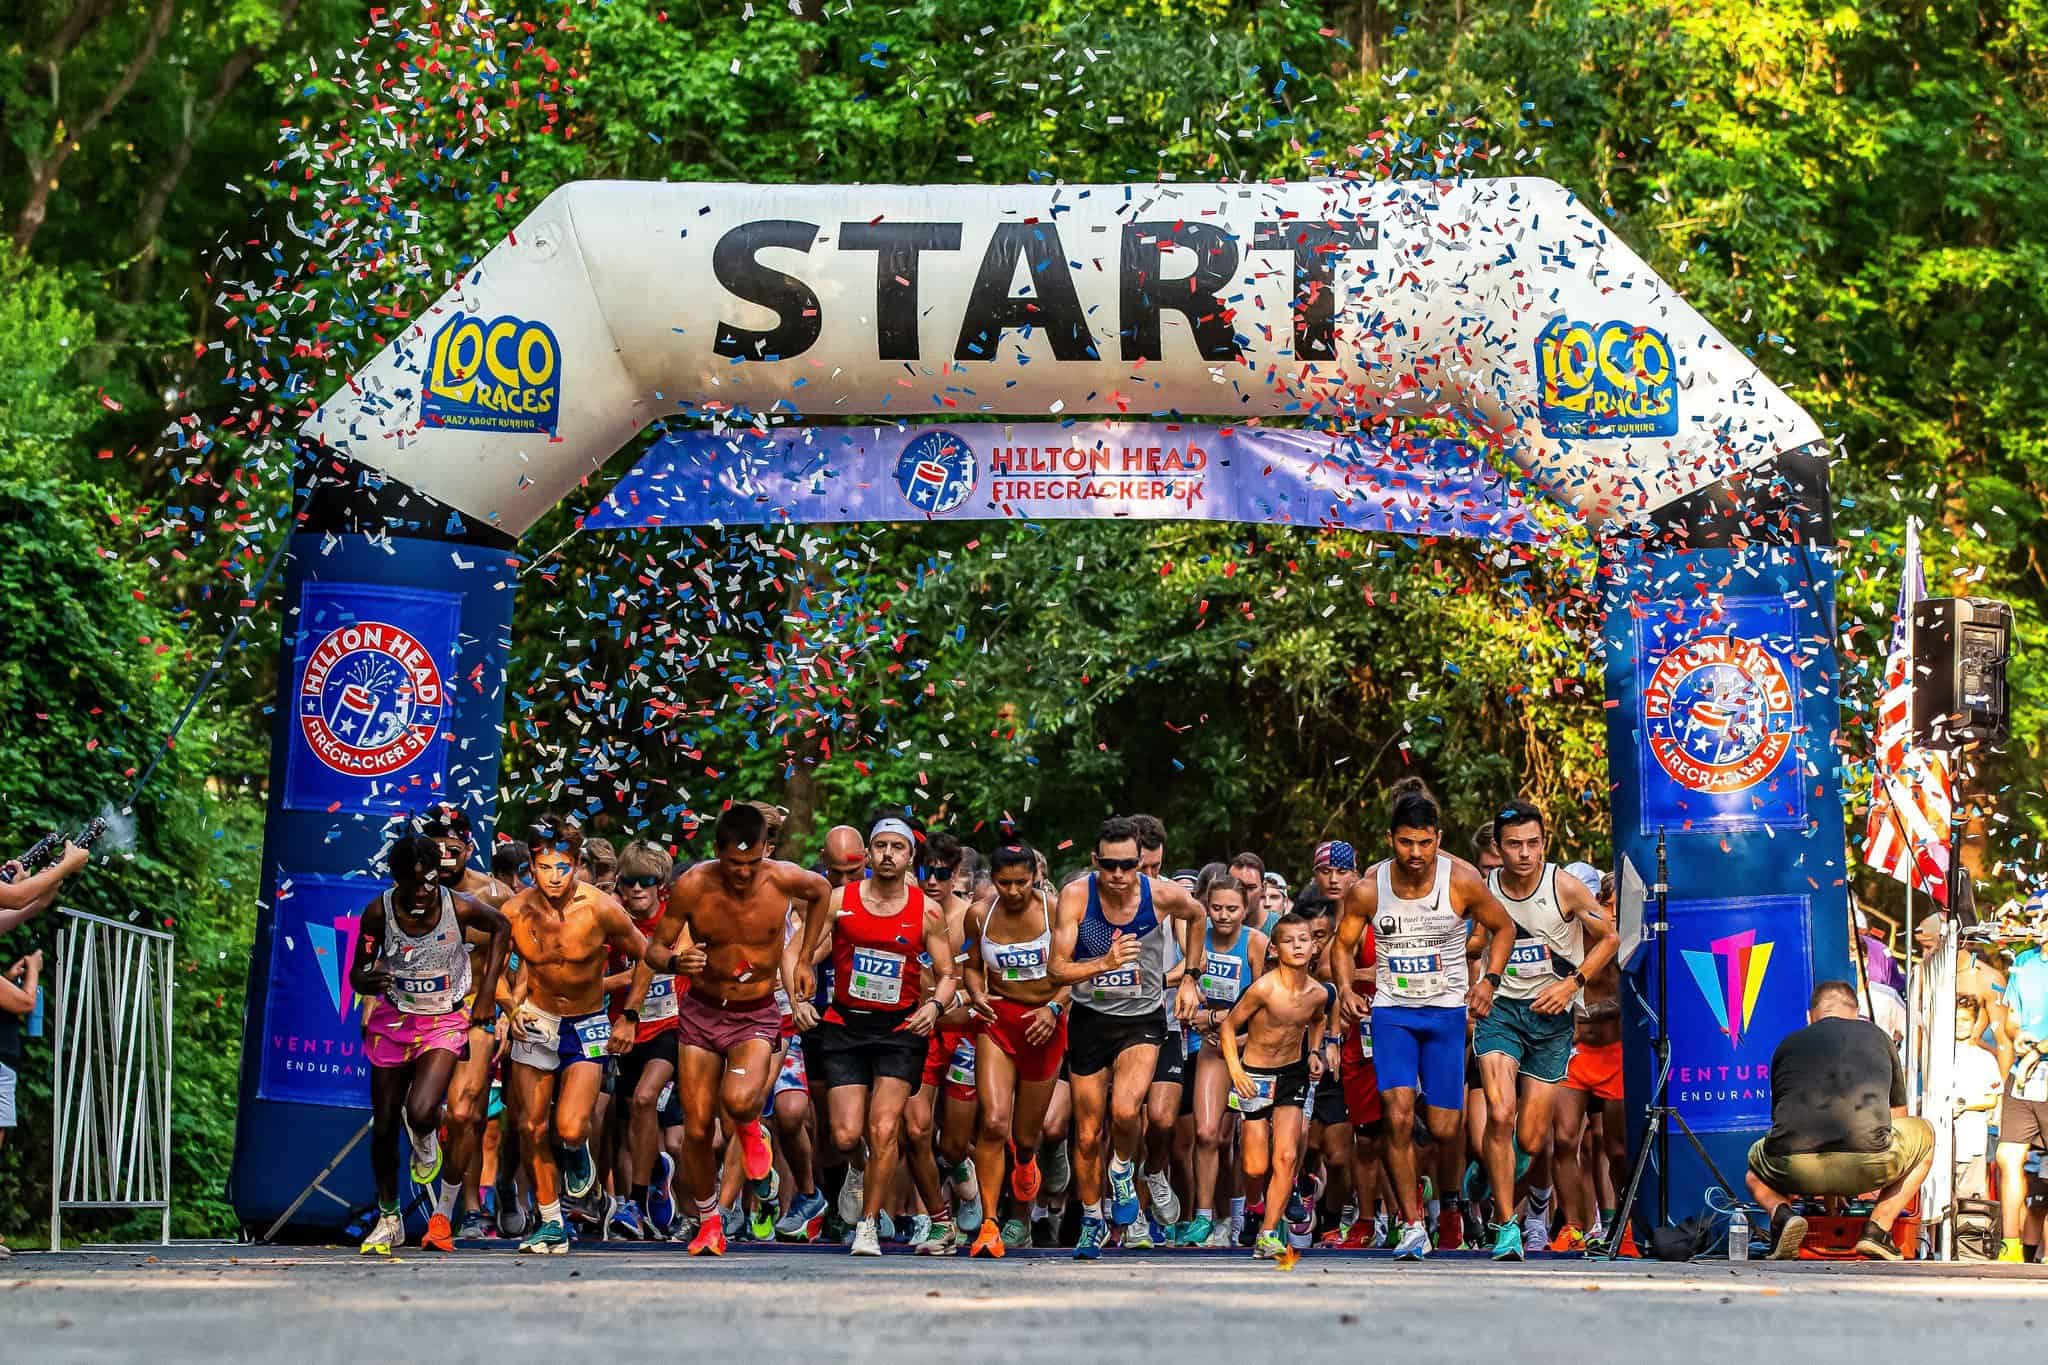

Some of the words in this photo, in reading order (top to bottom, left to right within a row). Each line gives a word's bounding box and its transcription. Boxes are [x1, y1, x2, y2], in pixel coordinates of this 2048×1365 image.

[712, 219, 1379, 361] START
[429, 319, 555, 404] LOCO
[1542, 322, 1670, 412] LOCO
[476, 383, 555, 415] RACES
[992, 447, 1111, 472] HILTON
[1121, 447, 1208, 472] HEAD
[992, 480, 1166, 501] FIRECRACKER
[1172, 480, 1205, 501] 5K
[305, 626, 382, 695] HILTON
[387, 634, 438, 703] HEAD
[308, 719, 409, 769] FIRECRACKER
[1762, 736, 1783, 760] 5K
[859, 957, 893, 975] 1172
[999, 952, 1039, 967] 1938
[1393, 958, 1431, 973] 1313
[404, 979, 436, 992] 810
